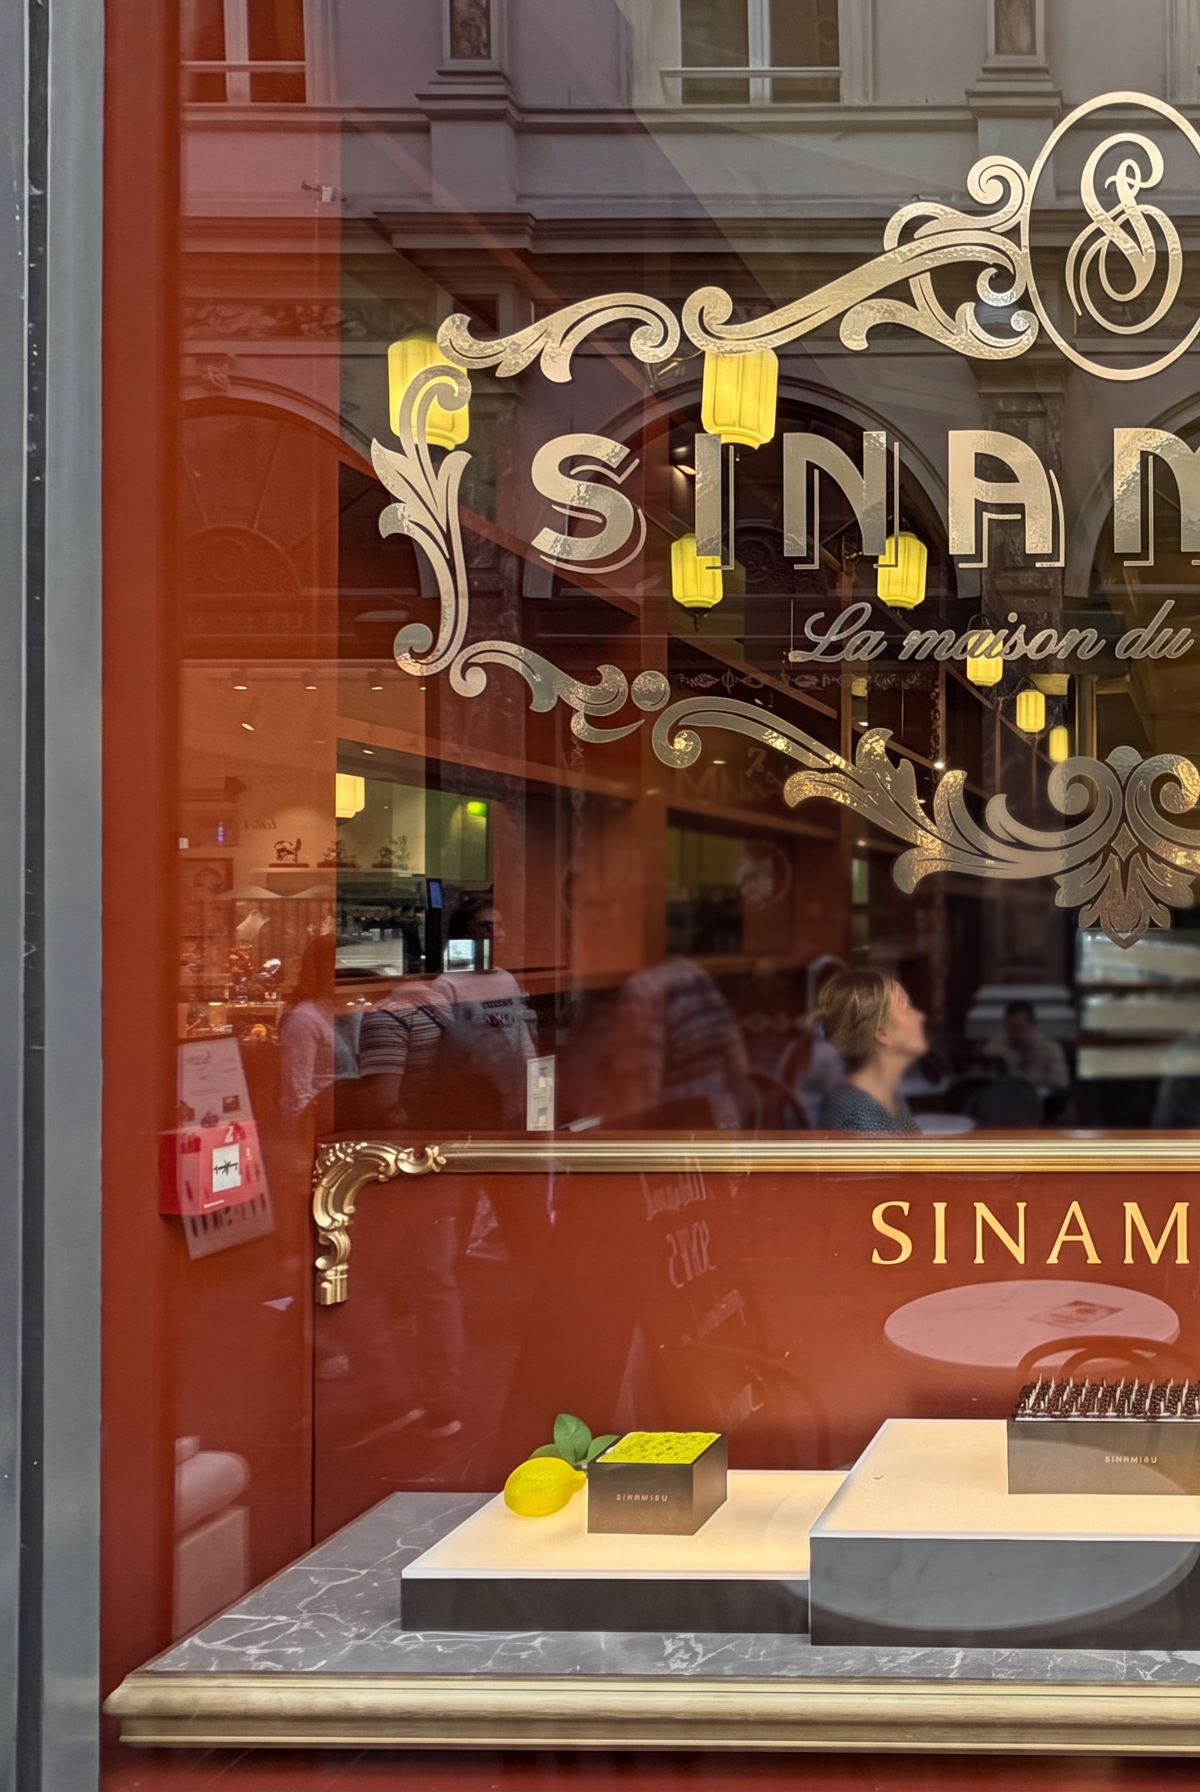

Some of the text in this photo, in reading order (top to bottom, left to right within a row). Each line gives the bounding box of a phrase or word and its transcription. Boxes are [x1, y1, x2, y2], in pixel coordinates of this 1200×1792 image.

[789, 601, 887, 663] La
[898, 612, 1105, 662] maison
[1114, 600, 1194, 661] du
